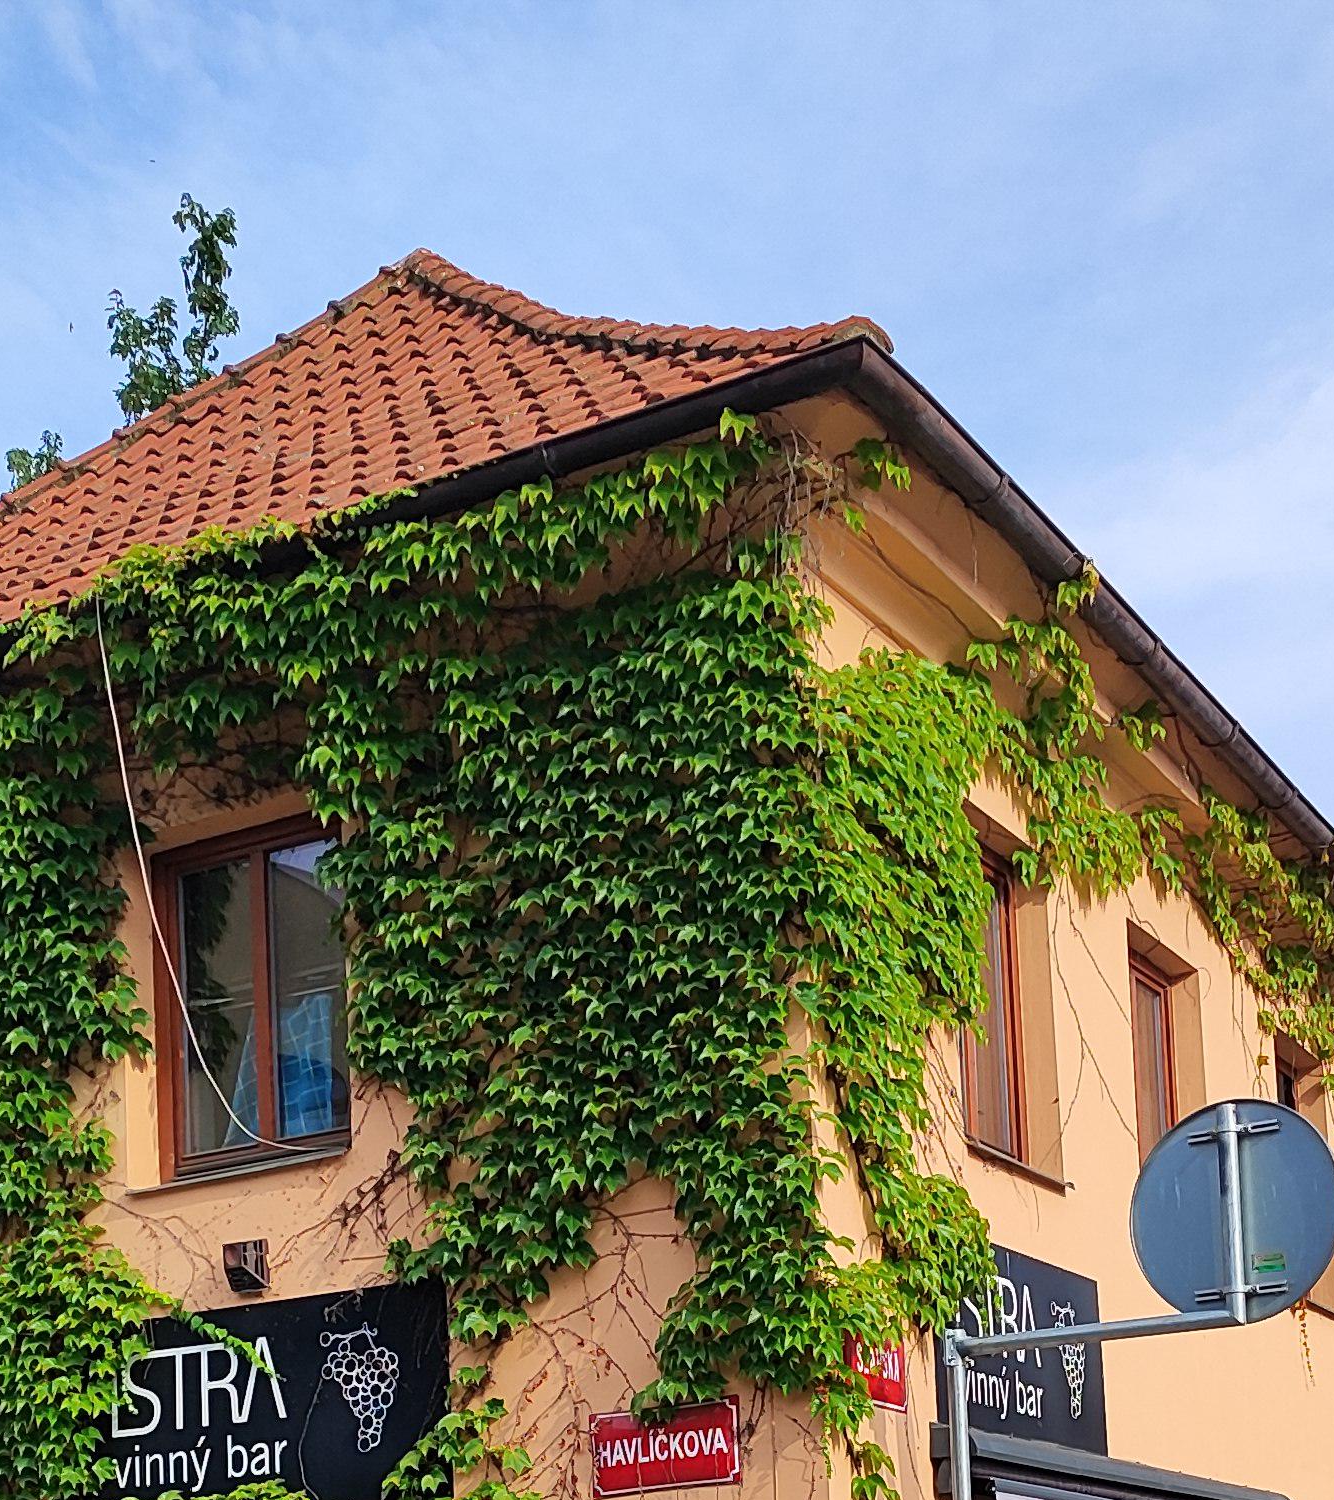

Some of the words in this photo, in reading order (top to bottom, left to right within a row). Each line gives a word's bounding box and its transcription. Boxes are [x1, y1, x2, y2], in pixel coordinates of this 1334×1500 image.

[1015, 1370, 1044, 1419] bar
[113, 1436, 211, 1493] vinný
[227, 1434, 288, 1479] bar
[599, 1427, 729, 1468] HAVLÍČKOVA
